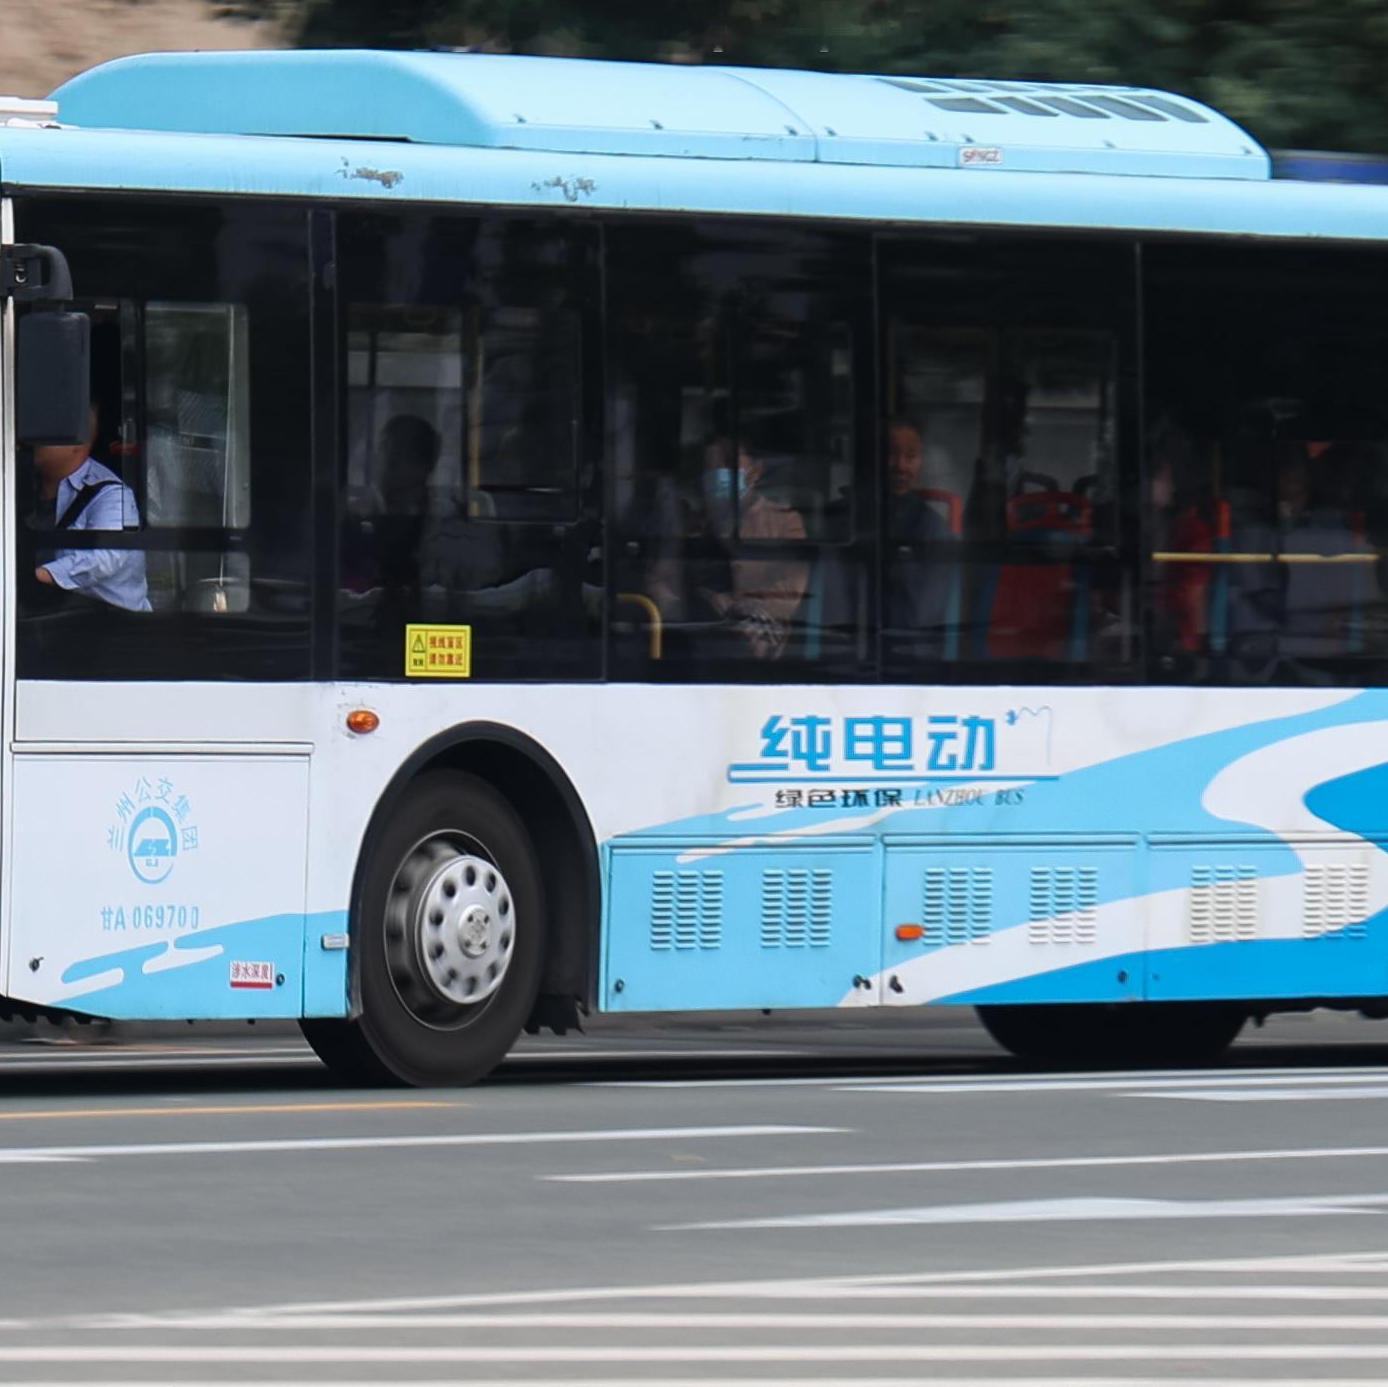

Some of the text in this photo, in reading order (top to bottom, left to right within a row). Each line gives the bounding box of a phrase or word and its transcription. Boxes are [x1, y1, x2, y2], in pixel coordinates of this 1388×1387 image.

[759, 714, 996, 771] 纯电动
[107, 776, 199, 853] 兰州公交集团
[774, 788, 902, 809] 绿色环保
